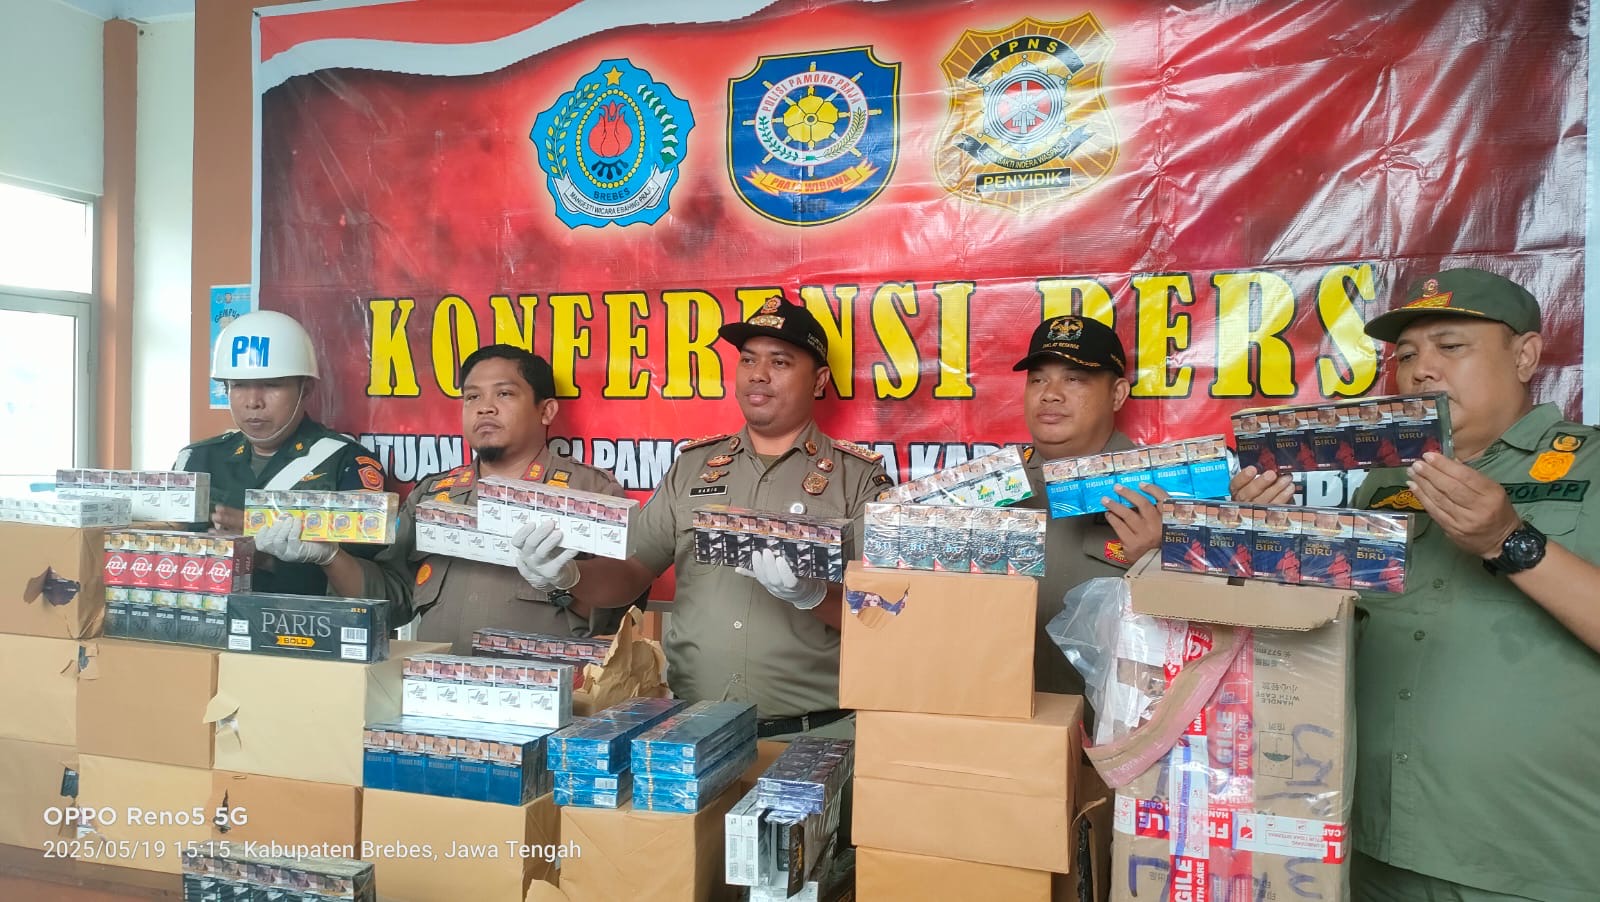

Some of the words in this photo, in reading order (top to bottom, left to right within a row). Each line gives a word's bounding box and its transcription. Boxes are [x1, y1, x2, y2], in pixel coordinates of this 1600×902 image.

[990, 38, 1058, 61] PPNS
[762, 84, 786, 112] POLISI
[788, 73, 834, 88] PAMONG
[835, 78, 858, 105] PRAJA
[983, 171, 1063, 189] PENYIDIK
[594, 188, 630, 200] BREBES
[594, 207, 616, 215] WICARA
[232, 335, 270, 368] PM
[1399, 431, 1423, 440] BIRU
[1545, 483, 1579, 497] PP
[1165, 536, 1189, 544] BIRU
[1210, 540, 1235, 548] BIRU
[1255, 543, 1282, 552] BIRU
[1305, 547, 1333, 556] BIRU
[1356, 551, 1386, 560] BIRU
[106, 561, 127, 571] AZZA
[130, 561, 153, 572] AZZA
[155, 563, 178, 574] AZZA
[181, 565, 204, 576] AZZA
[208, 566, 231, 577] AZZA
[261, 611, 332, 638] PARIS
[1238, 713, 1249, 740] CARE
[1238, 743, 1249, 769] WITH
[1196, 861, 1205, 885] CARE
